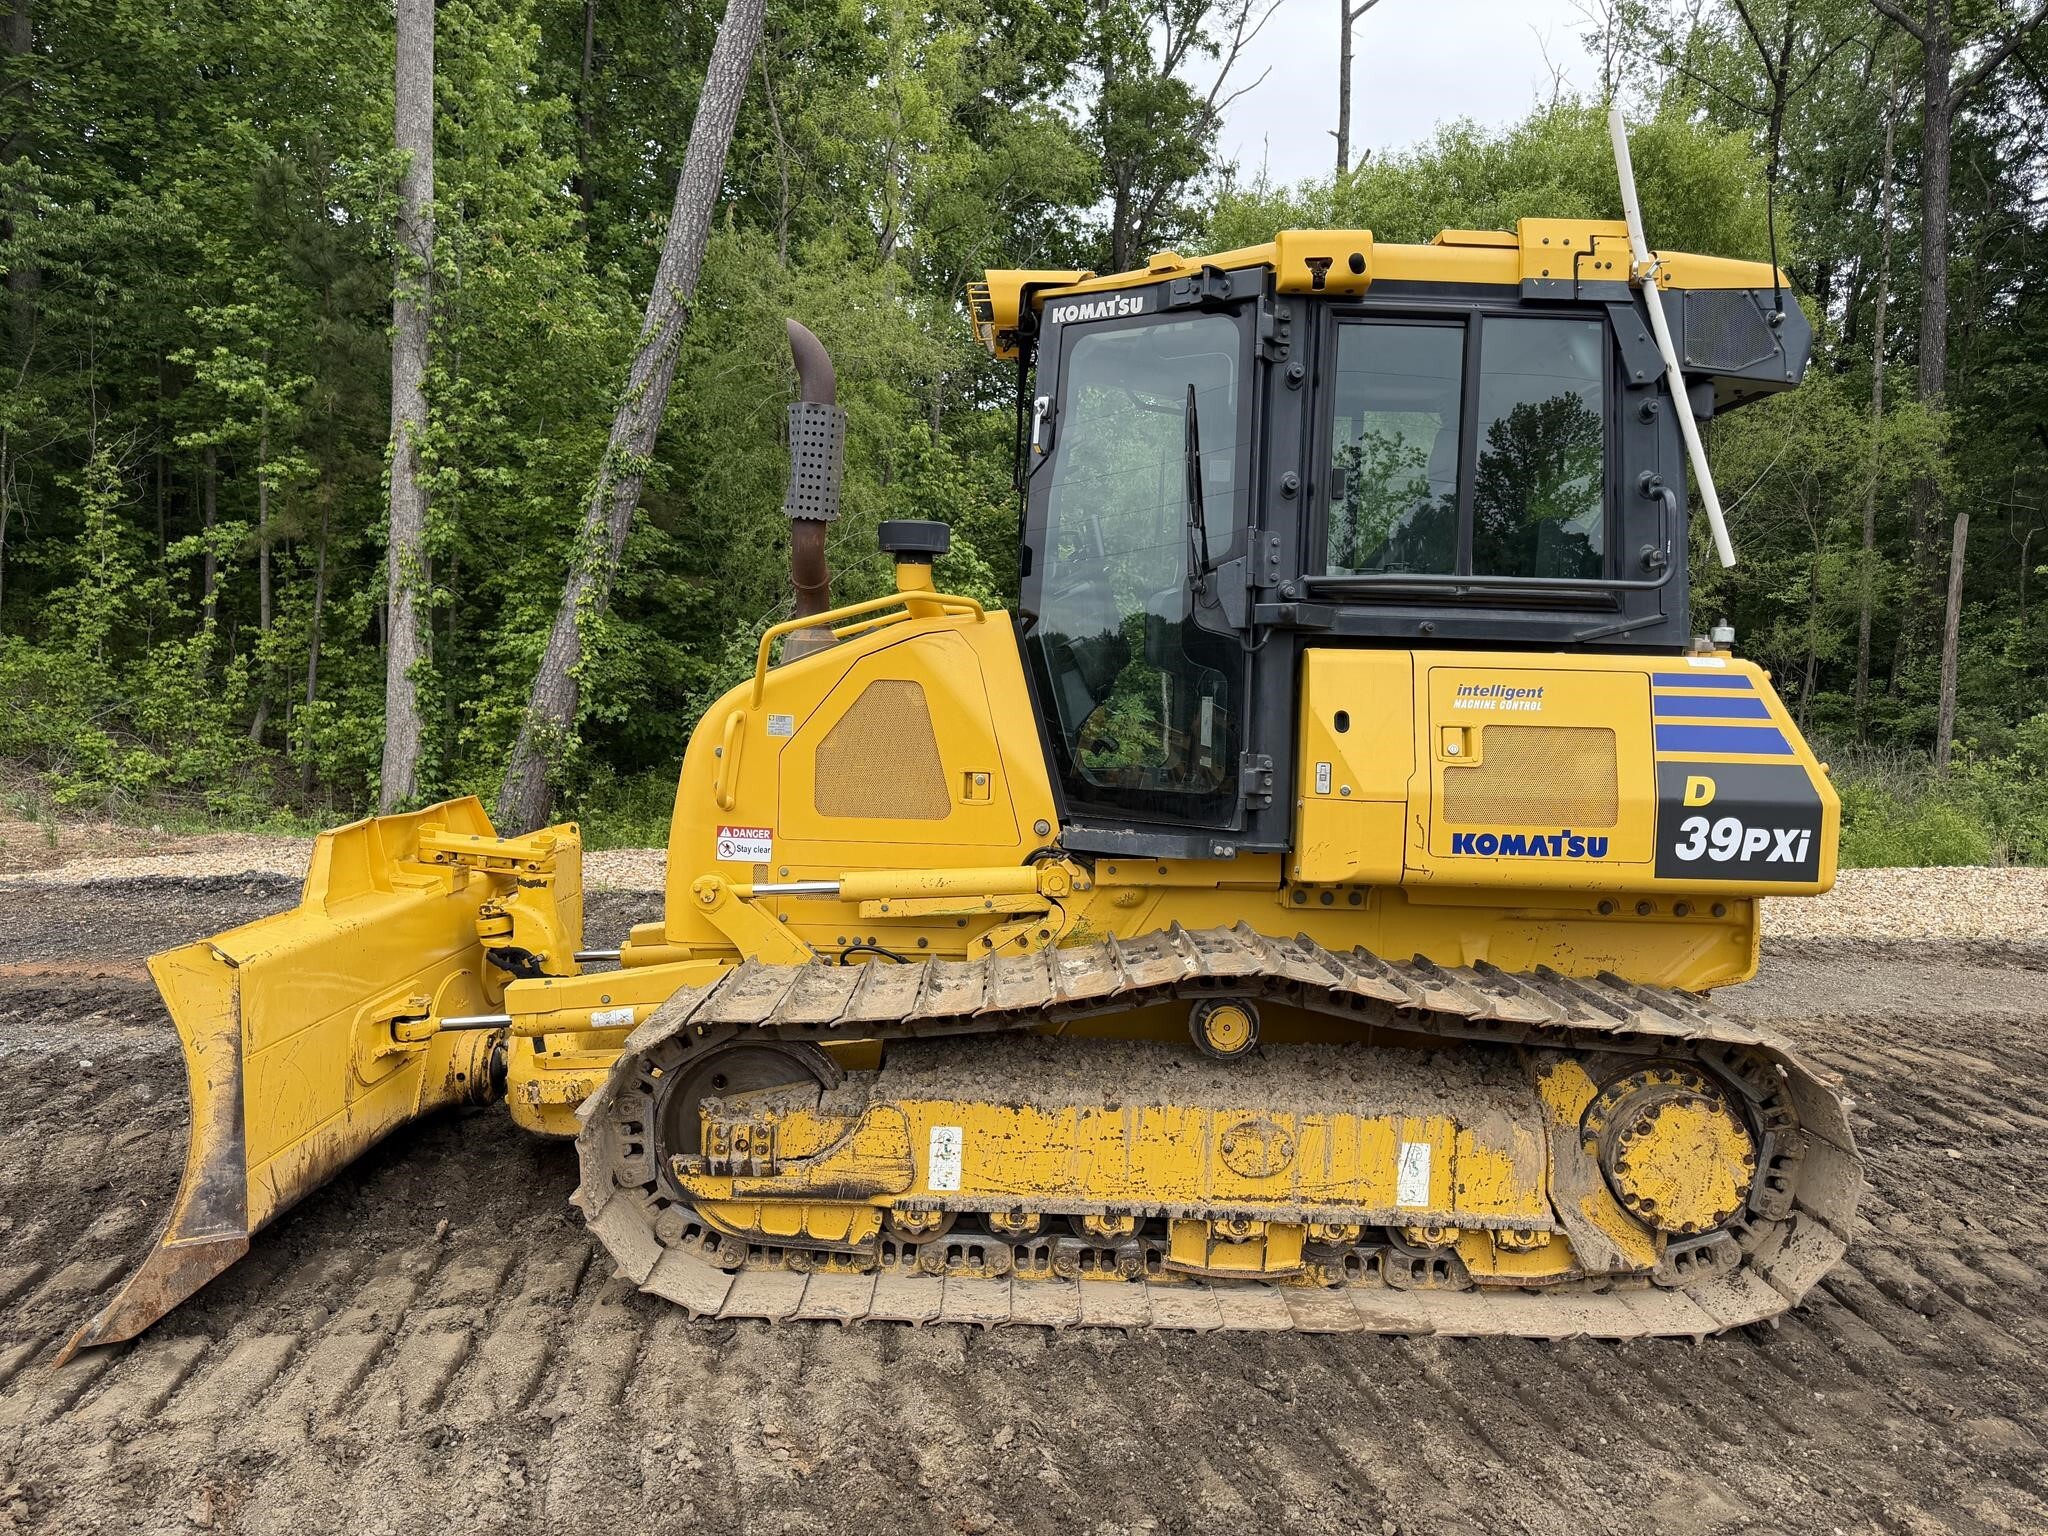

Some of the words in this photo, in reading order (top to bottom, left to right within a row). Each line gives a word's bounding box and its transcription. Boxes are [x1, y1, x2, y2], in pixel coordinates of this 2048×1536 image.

[1052, 295, 1144, 324] KOMATSU
[1457, 684, 1544, 700] intelligent
[1453, 699, 1496, 710] MACHINE
[1499, 700, 1543, 711] CONTROL
[1683, 776, 1716, 807] D
[733, 829, 770, 838] DANGER
[1452, 829, 1608, 858] KOMATSU
[1675, 816, 1812, 863] 39PXi
[736, 845, 752, 855] Stay
